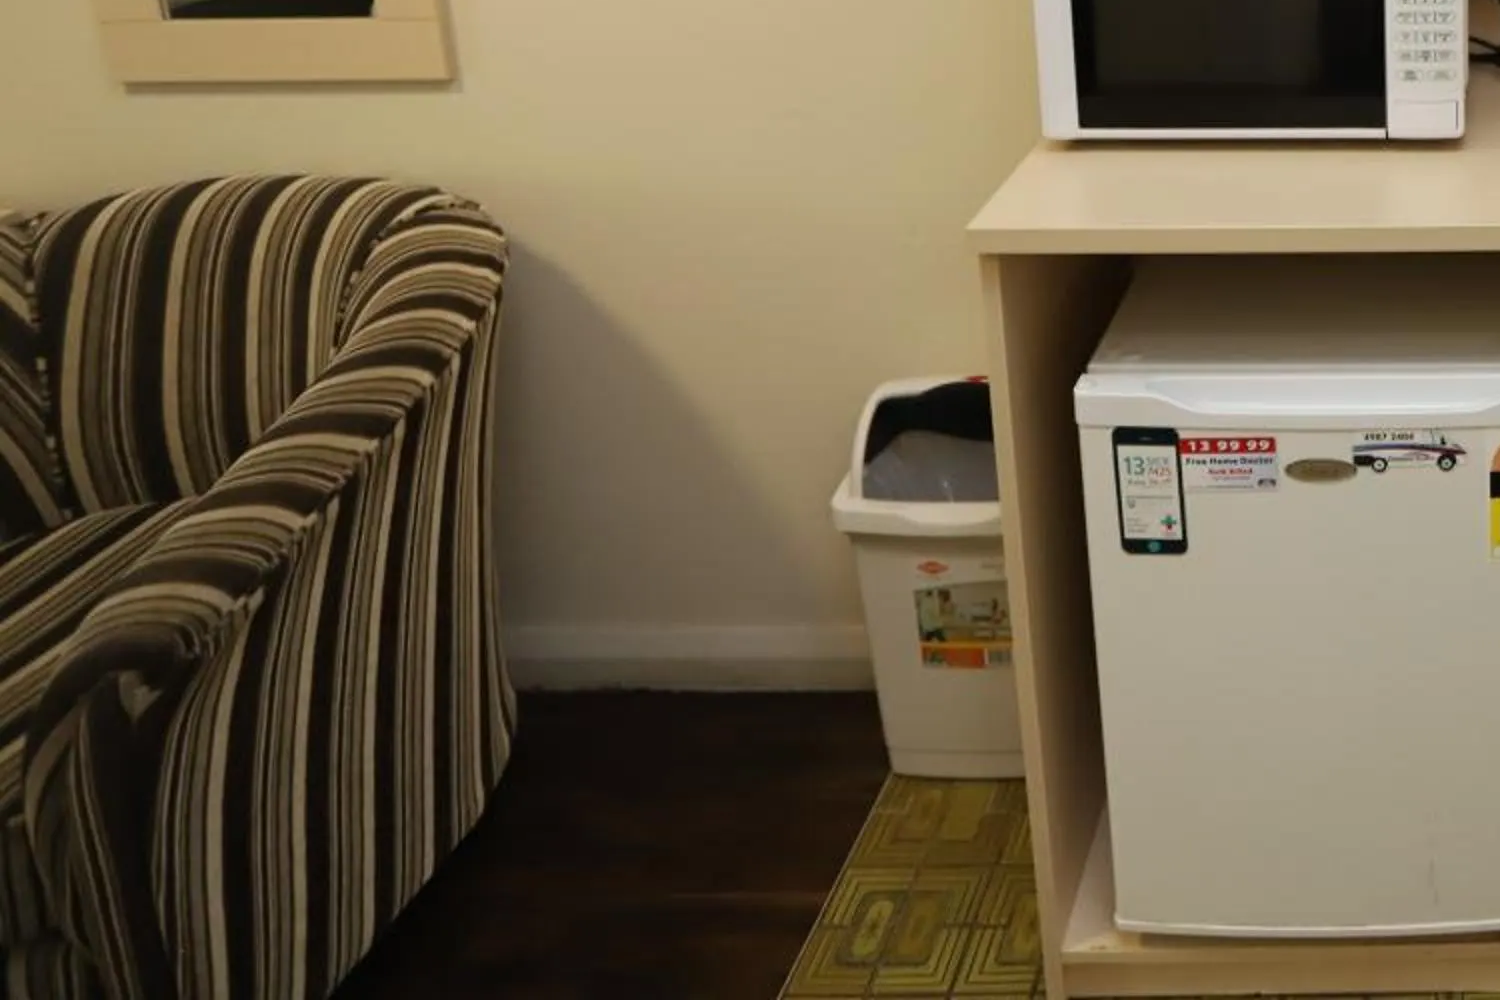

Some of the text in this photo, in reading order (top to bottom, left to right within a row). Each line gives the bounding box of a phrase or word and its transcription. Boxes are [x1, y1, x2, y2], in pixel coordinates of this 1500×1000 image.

[1188, 440, 1270, 452] 13 99 99
[1124, 456, 1145, 475] 13
[1185, 457, 1207, 466] Free
